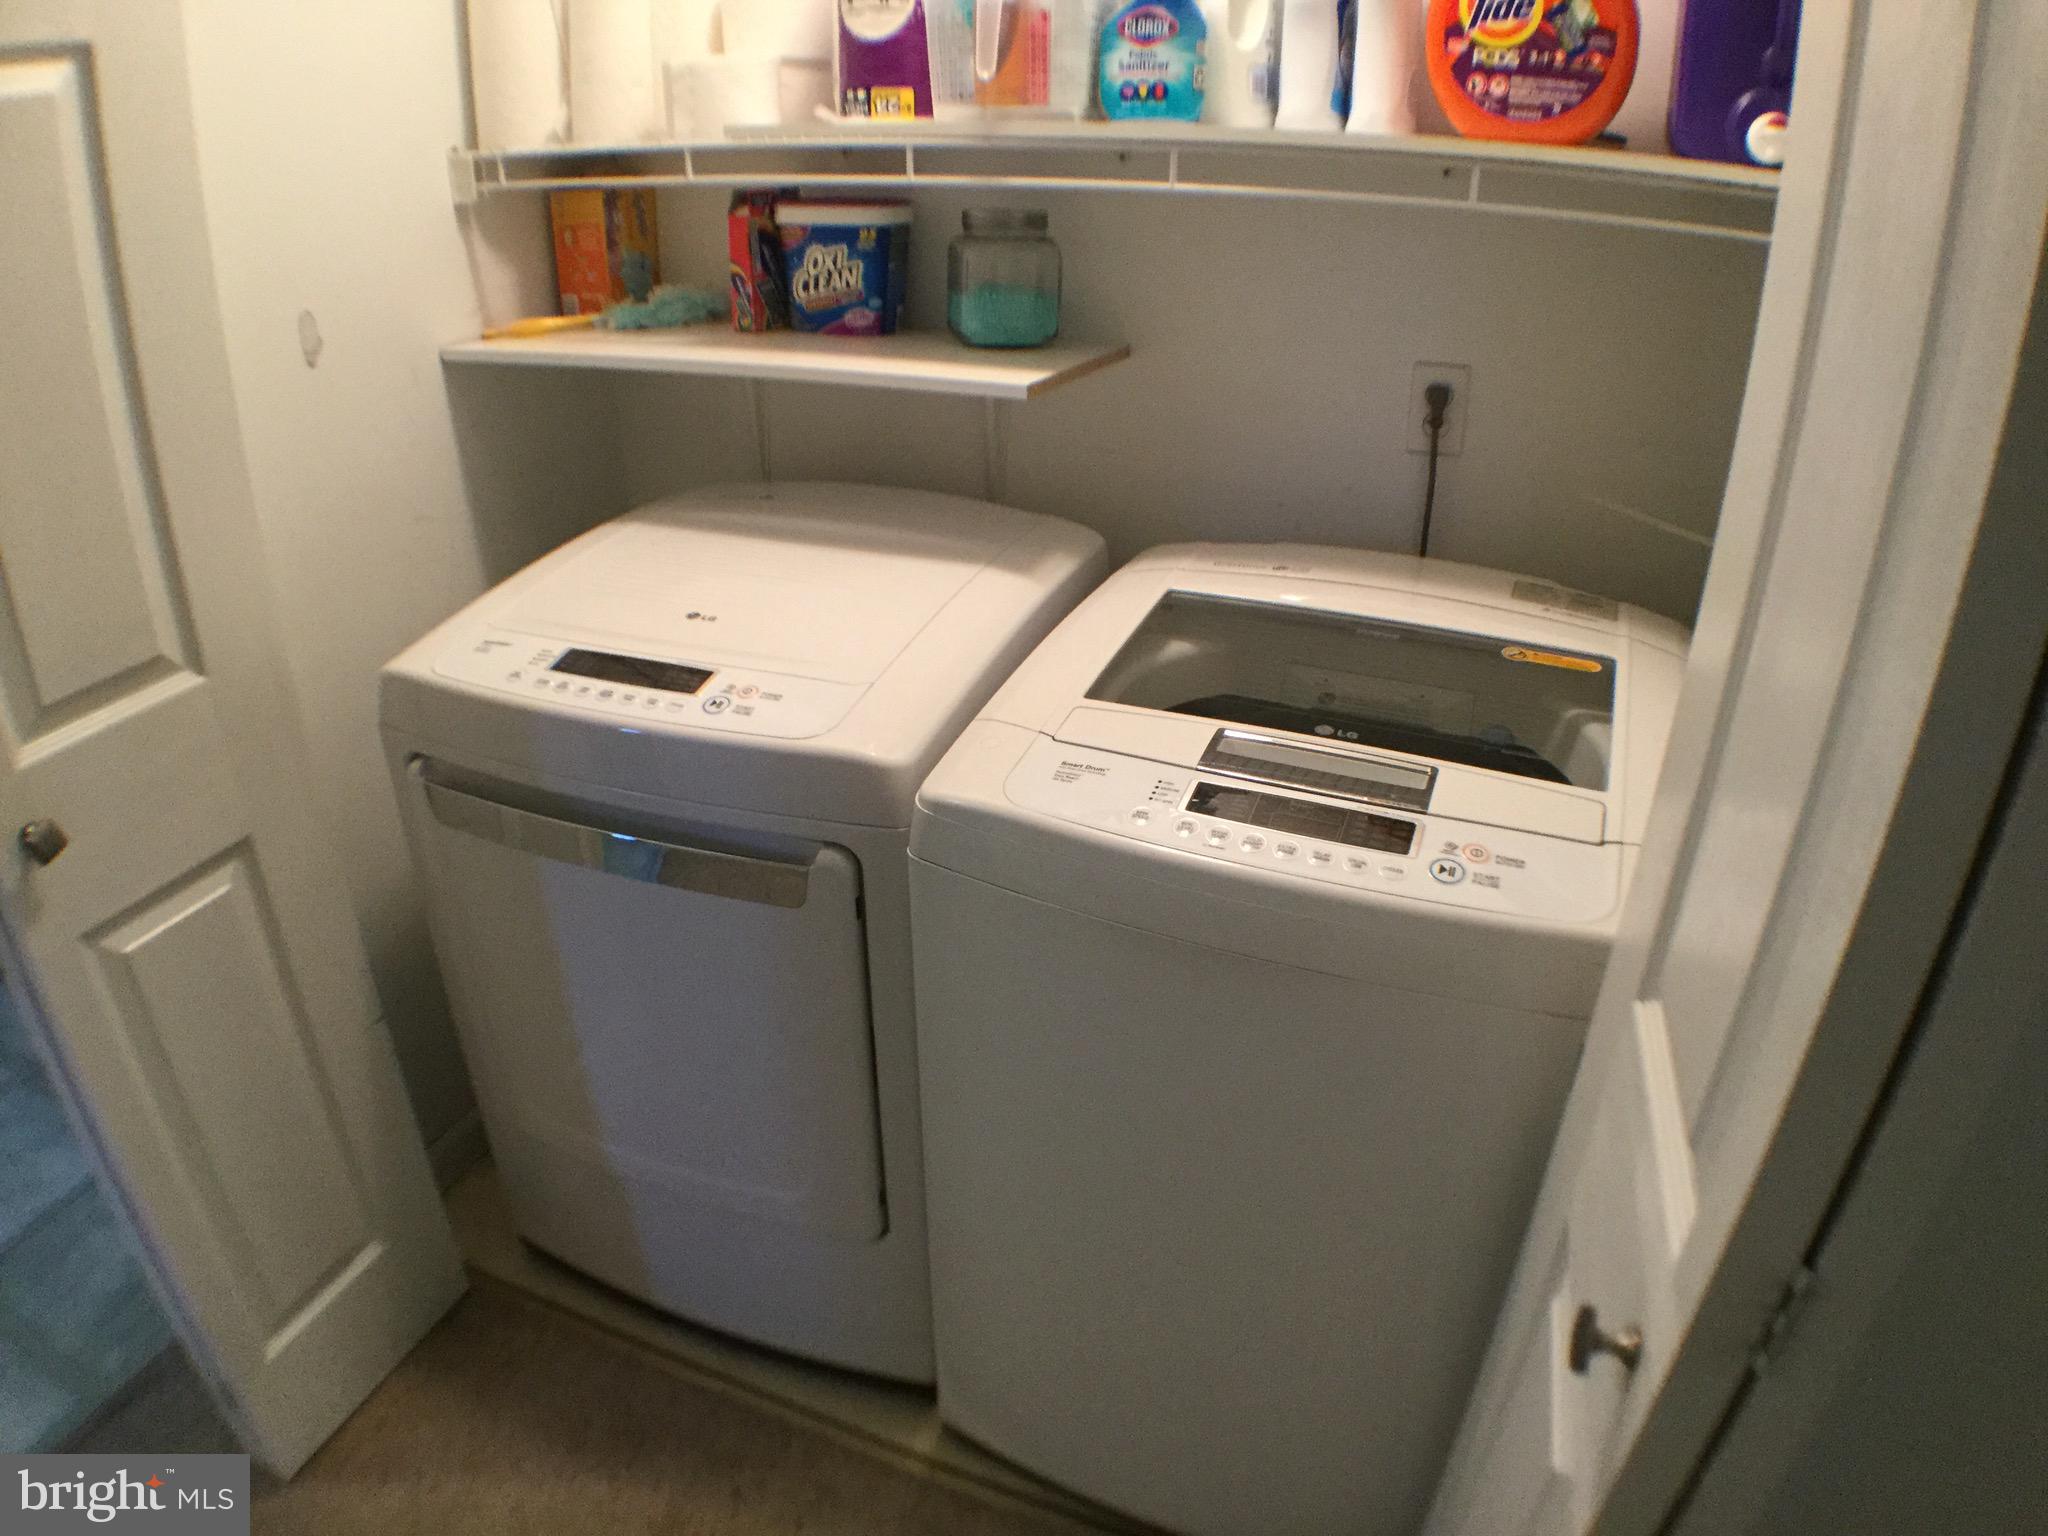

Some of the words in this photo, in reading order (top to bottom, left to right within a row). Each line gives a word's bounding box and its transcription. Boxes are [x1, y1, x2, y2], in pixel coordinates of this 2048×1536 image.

[1124, 16, 1170, 37] CLOROX
[806, 246, 848, 276] OXI
[794, 261, 863, 302] CLEAN
[1336, 728, 1360, 740] LG
[1060, 760, 1084, 769] Smart
